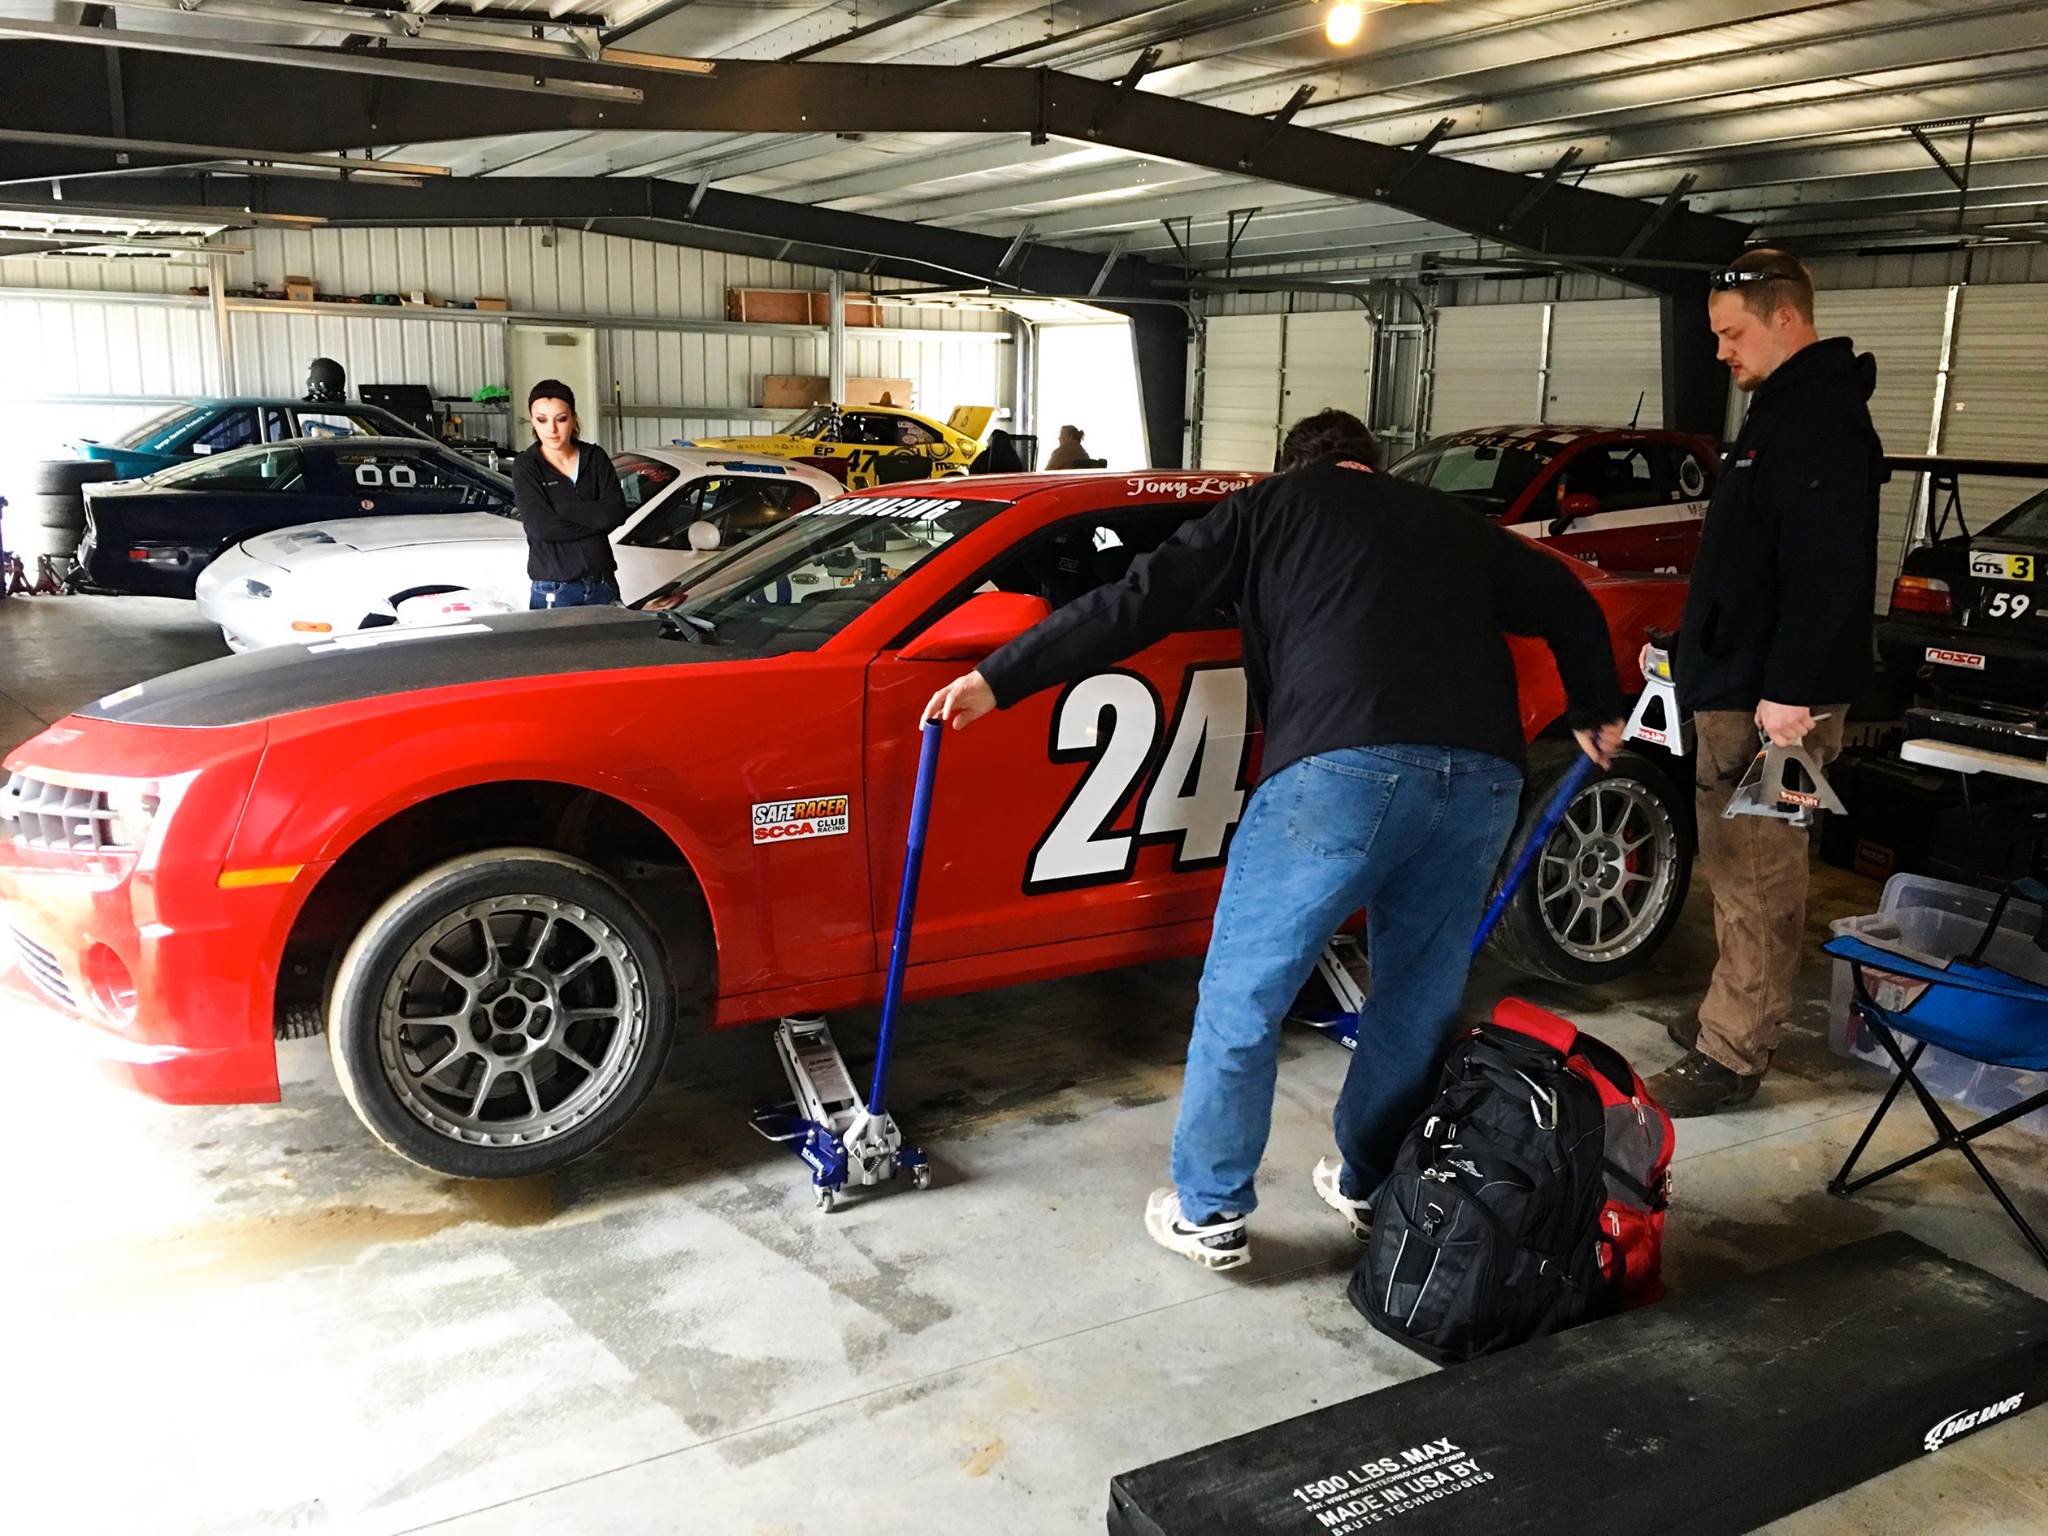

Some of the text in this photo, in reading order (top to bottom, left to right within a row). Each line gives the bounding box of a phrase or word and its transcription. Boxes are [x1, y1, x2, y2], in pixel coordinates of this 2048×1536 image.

[813, 446, 836, 457] EP
[848, 448, 880, 473] 47
[355, 463, 417, 488] 00
[1126, 477, 1189, 499] Tony
[848, 497, 963, 522] RACING
[1971, 556, 2030, 579] GTS 3
[1988, 592, 2031, 620] 59
[1028, 665, 1249, 884] 24
[754, 821, 815, 840] SCCA
[816, 817, 846, 828] CLUB
[816, 824, 846, 833] RACING
[1941, 1391, 2025, 1440] RACE RAMPS
[1292, 1475, 1350, 1503] 1500
[1315, 1457, 1481, 1528] MADE IN USA BY
[1306, 1501, 1327, 1512] PAT.
[1330, 1471, 1495, 1536] BRUTE TECHNOLOGIES
